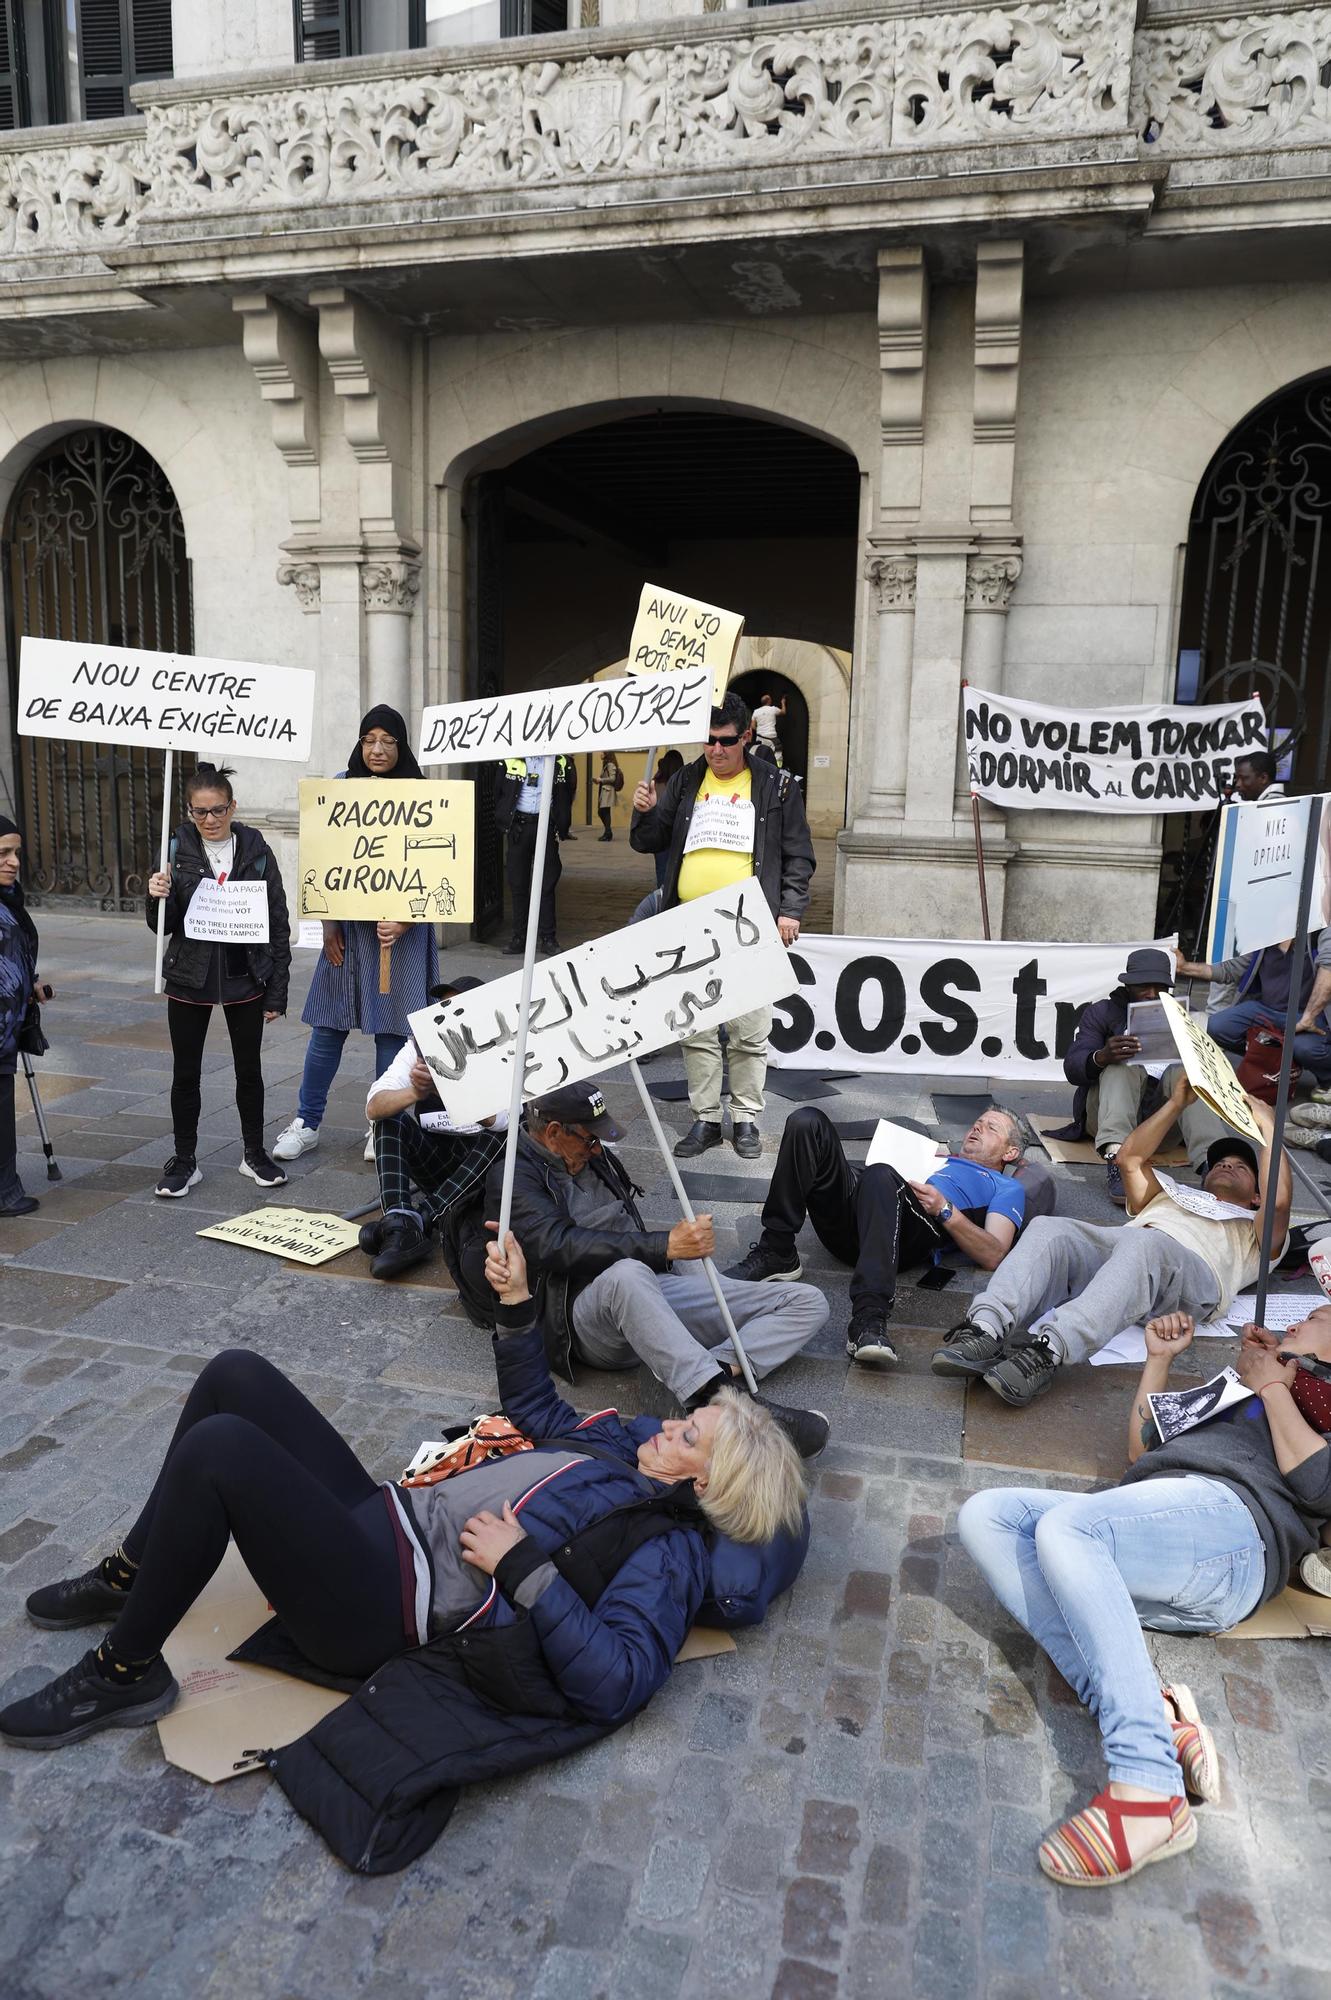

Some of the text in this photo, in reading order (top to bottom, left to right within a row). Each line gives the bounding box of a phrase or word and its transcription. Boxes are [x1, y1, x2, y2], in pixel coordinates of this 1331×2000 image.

[647, 599, 721, 636] AVUI JO
[635, 645, 670, 672] POTS
[660, 629, 708, 663] DEMÀ
[72, 661, 256, 700] NOU CENTRE
[25, 697, 297, 743] DE BAIXA EXIGÈNCIA
[423, 675, 707, 753] DRET A UN SOSTRE
[966, 703, 1268, 760] NO VOLEM TORNAR
[1103, 780, 1128, 797] AL
[719, 837, 745, 847] TAMPOC
[1265, 818, 1286, 837] NIKE
[353, 835, 388, 859] DE
[1253, 843, 1291, 866] OPTICAL
[324, 865, 427, 894] GIRONA
[208, 920, 227, 928] TIREU
[714, 893, 760, 946] لا
[600, 928, 721, 1005] نحب
[664, 968, 723, 1039] في
[254, 1231, 324, 1257] HUMANS
